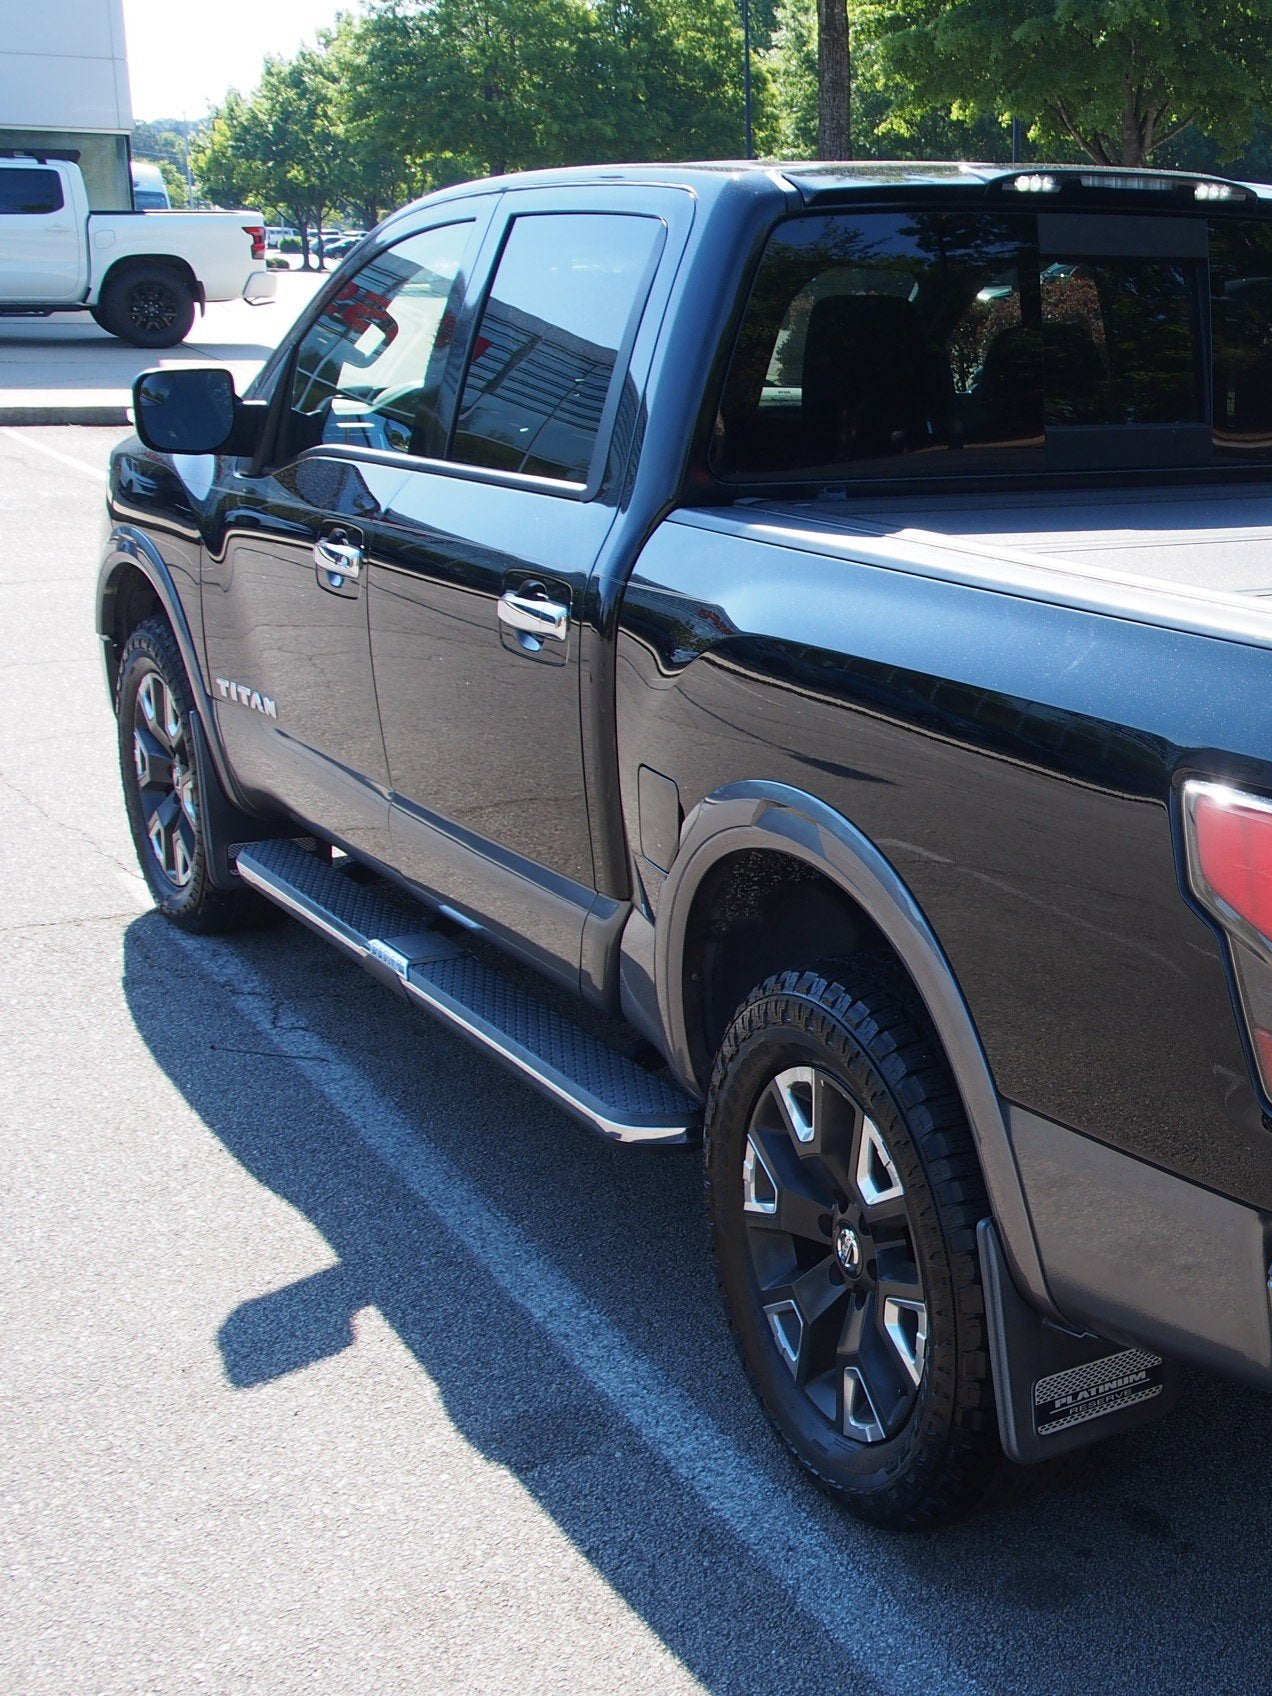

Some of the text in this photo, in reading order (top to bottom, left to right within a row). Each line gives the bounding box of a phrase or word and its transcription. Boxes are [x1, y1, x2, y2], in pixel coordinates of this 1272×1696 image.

[216, 678, 278, 719] TITAN
[1054, 1371, 1146, 1408] PLATINUM
[1069, 1388, 1133, 1415] RESERVE
